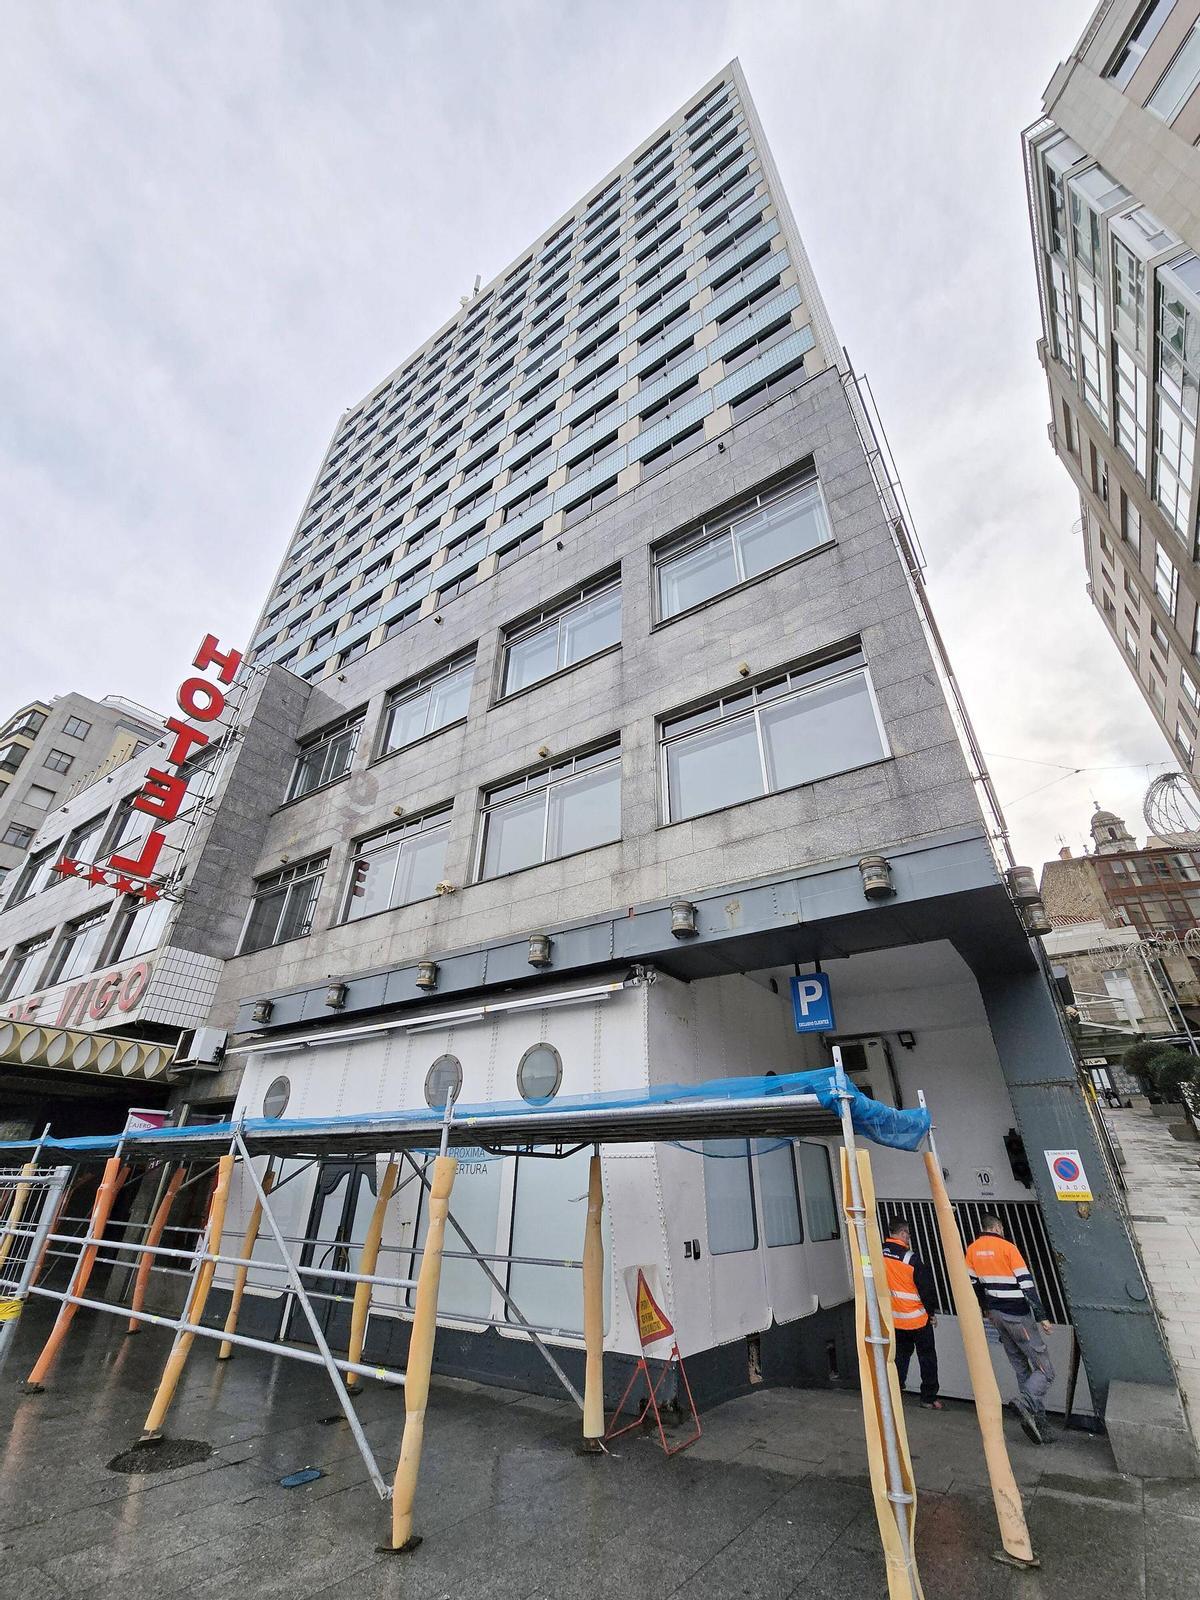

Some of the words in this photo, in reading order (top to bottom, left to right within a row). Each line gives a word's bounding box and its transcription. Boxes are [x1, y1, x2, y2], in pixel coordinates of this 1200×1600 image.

[55, 962, 153, 1027] VIGO
[798, 980, 822, 1016] P
[455, 1163, 488, 1175] ERTURA
[977, 1173, 990, 1184] 10
